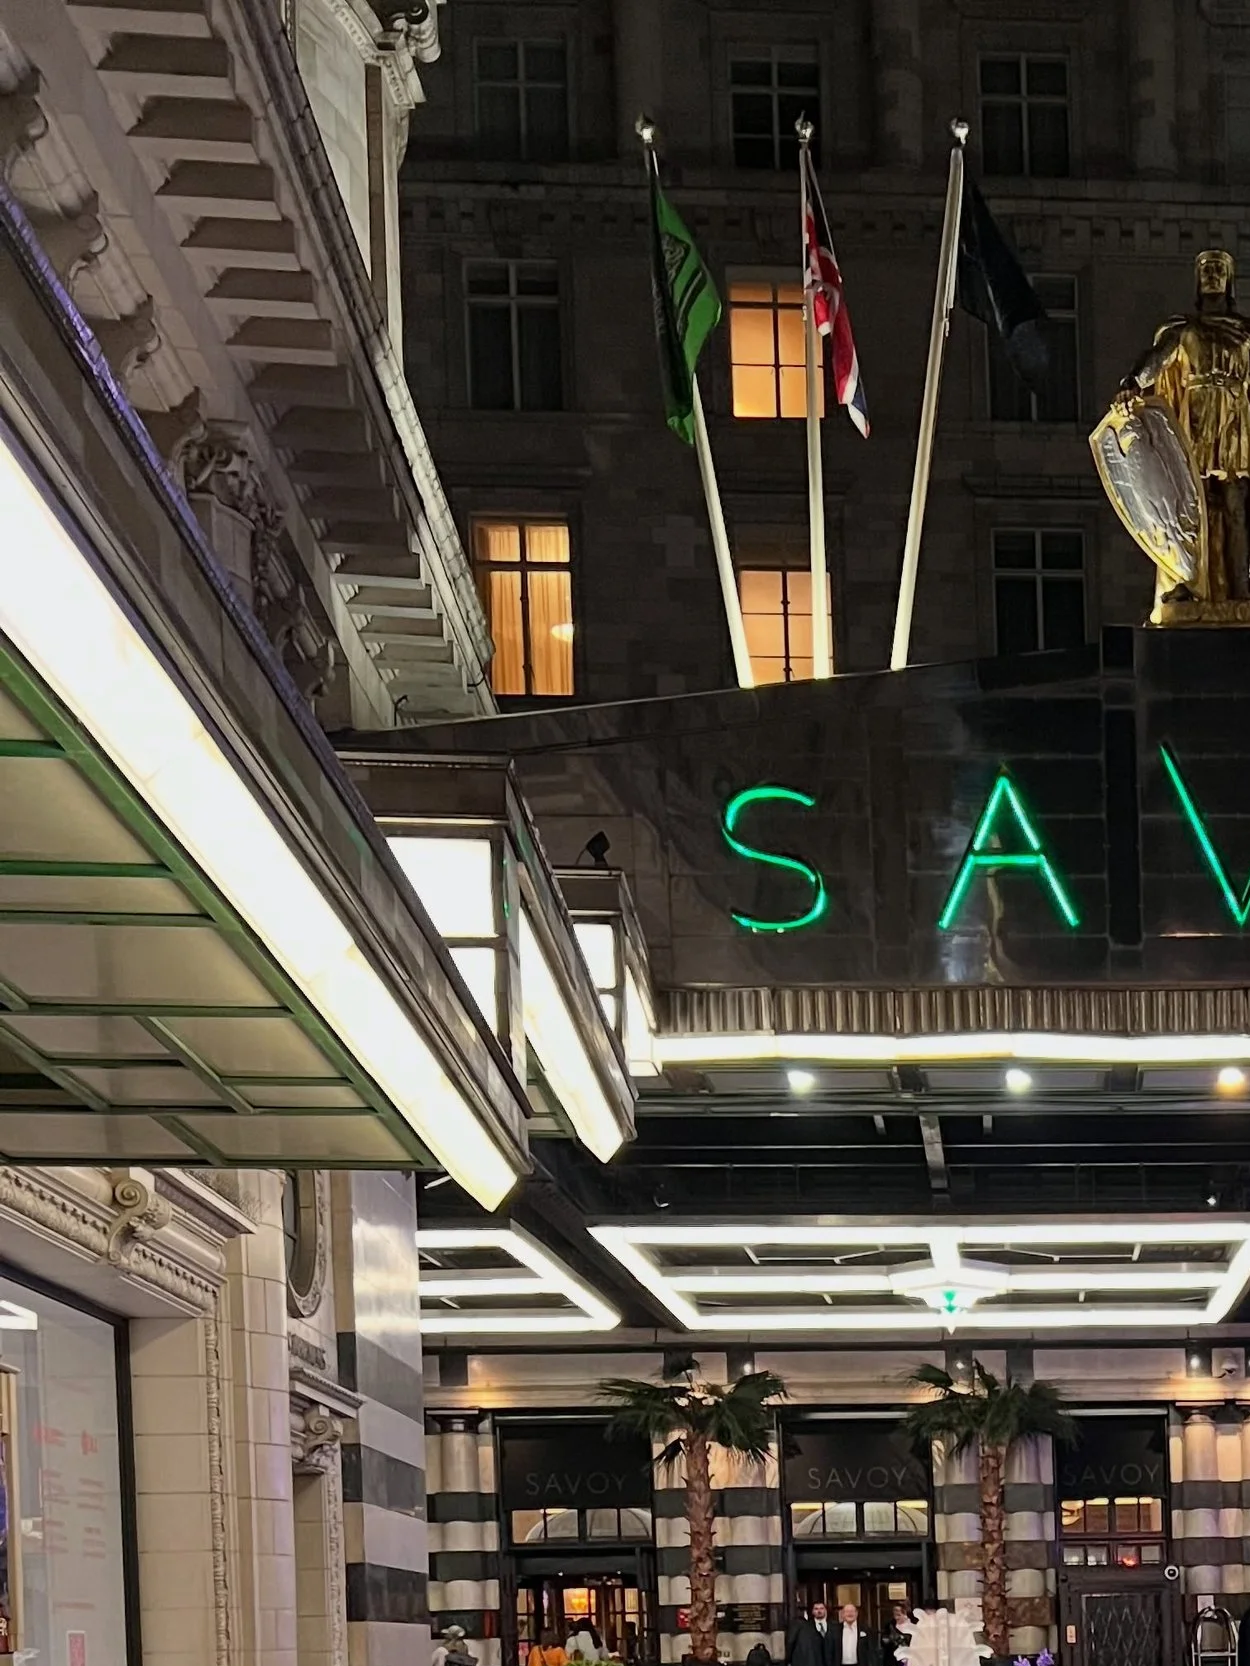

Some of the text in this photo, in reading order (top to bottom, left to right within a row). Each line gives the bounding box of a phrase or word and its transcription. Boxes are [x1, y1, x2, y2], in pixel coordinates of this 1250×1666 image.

[525, 1471, 629, 1497] SAVOY
[807, 1466, 908, 1490] SAVOY
[1062, 1463, 1160, 1487] SAVOY
